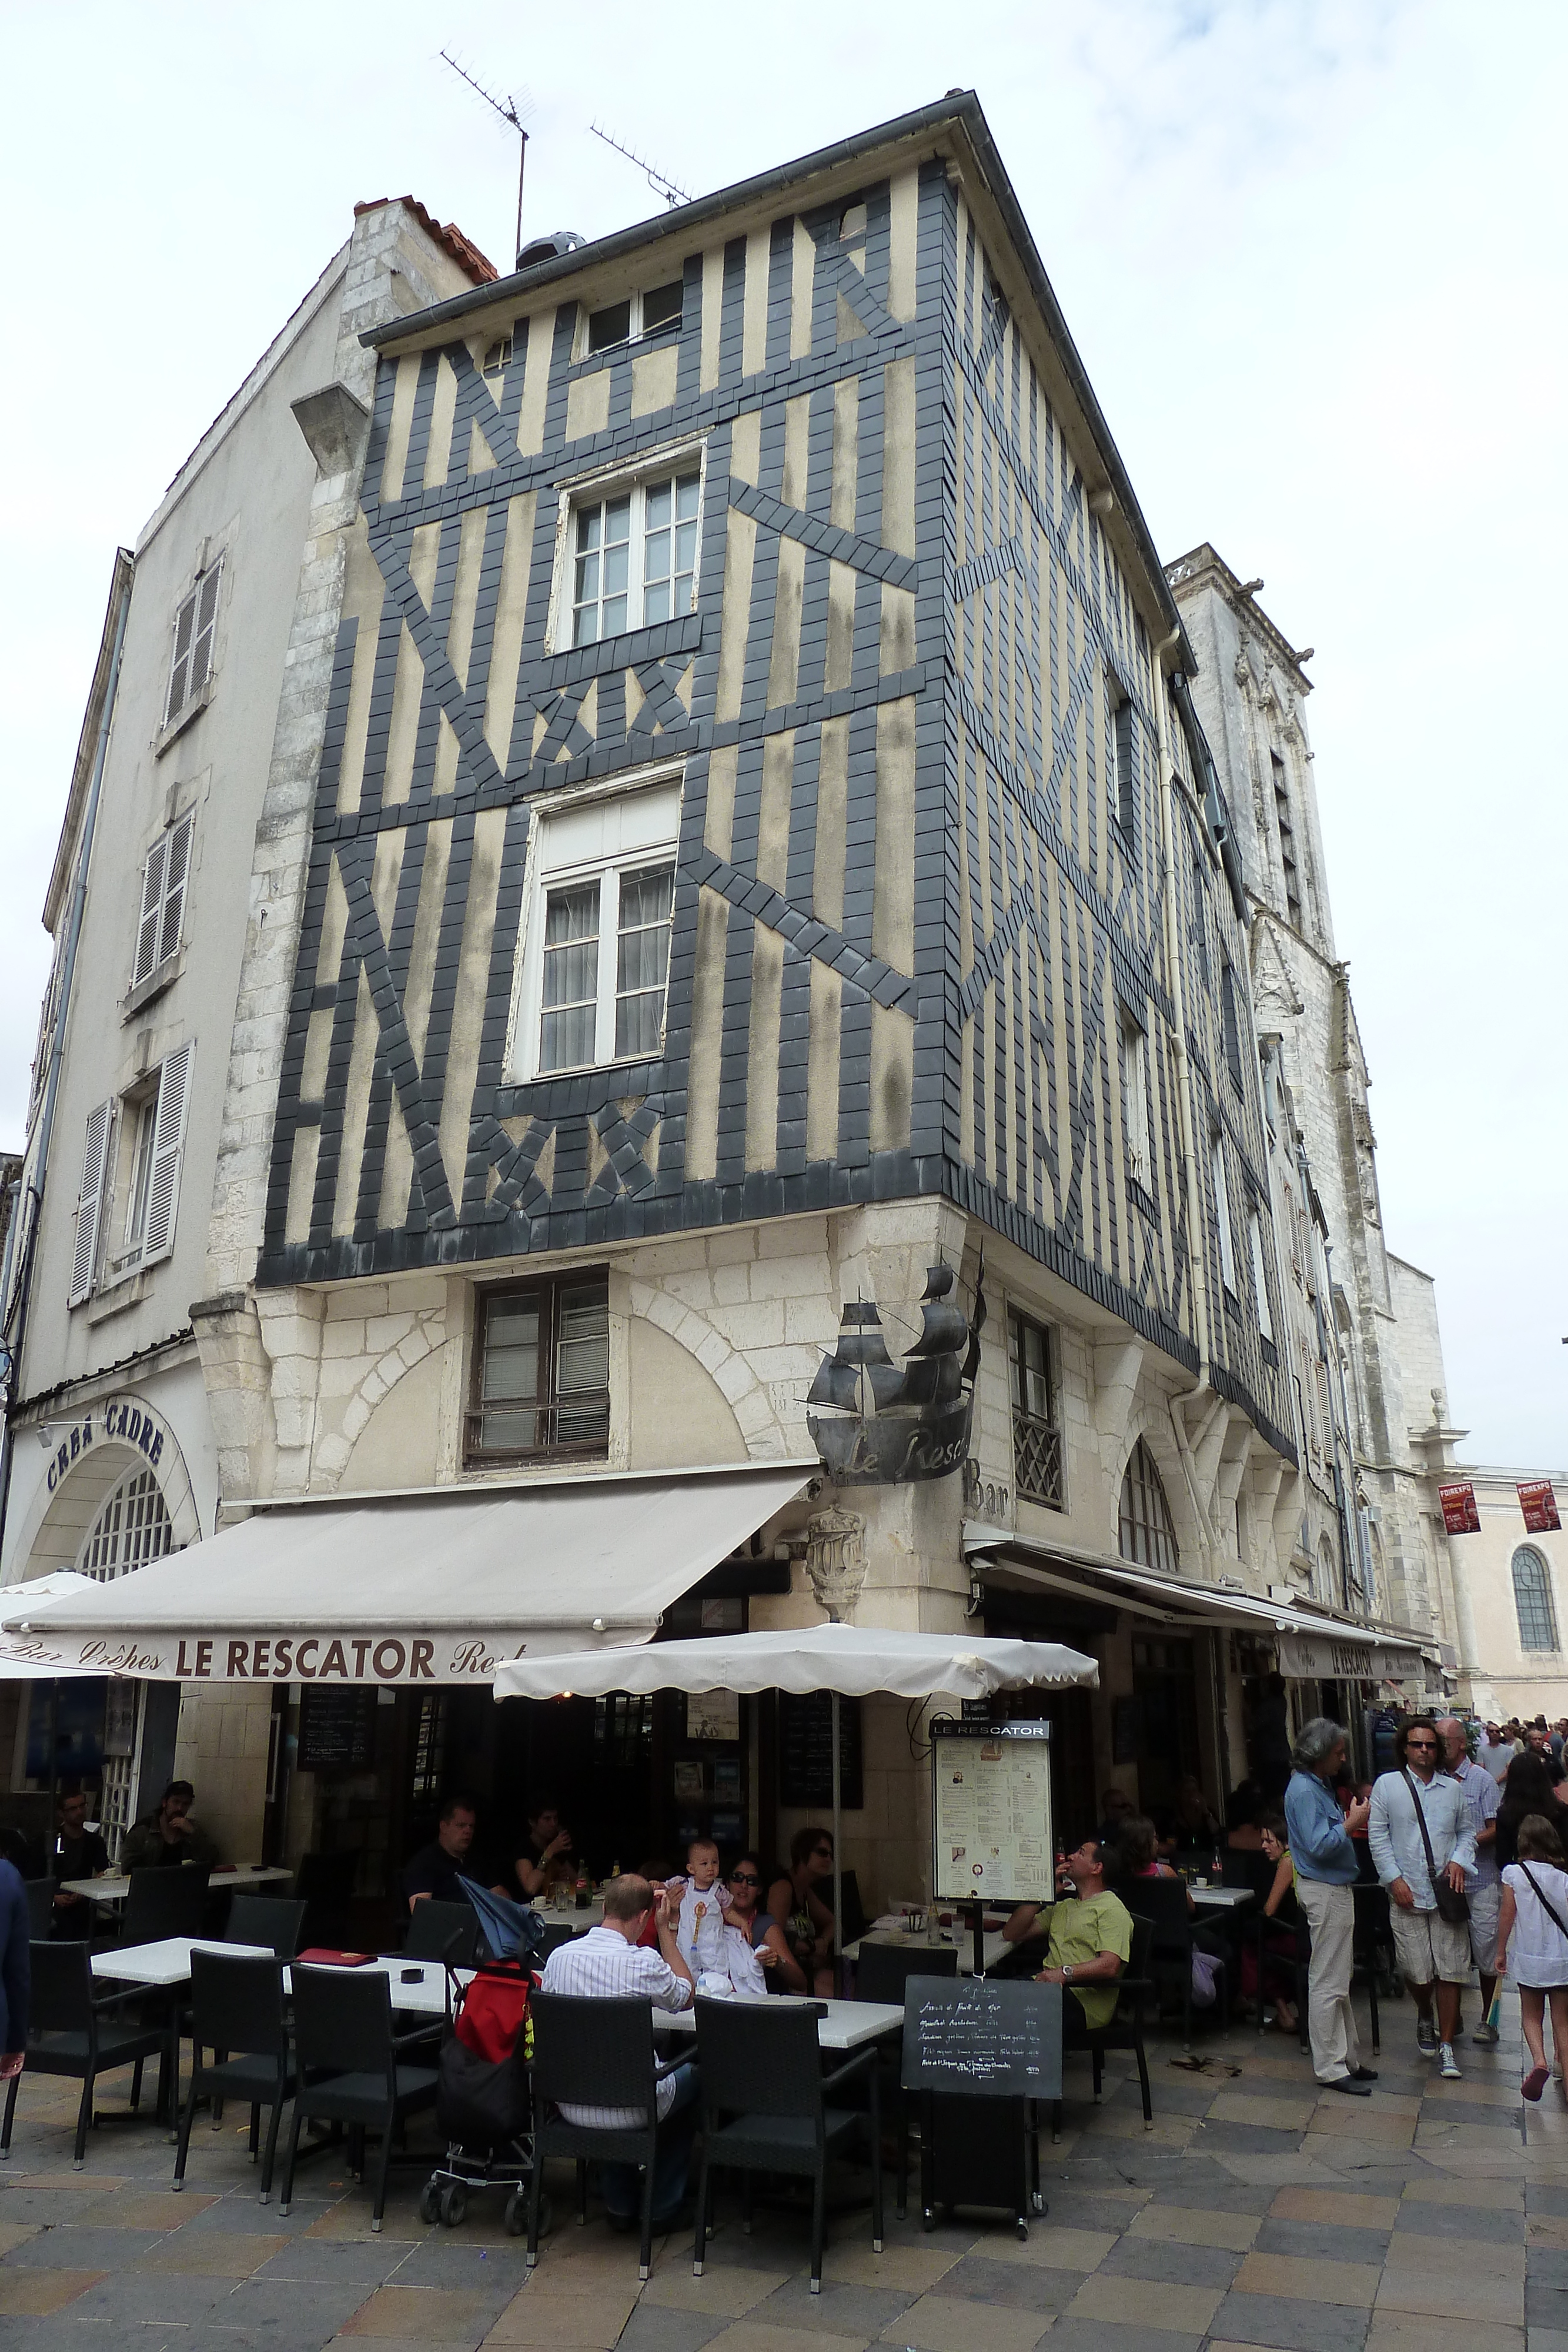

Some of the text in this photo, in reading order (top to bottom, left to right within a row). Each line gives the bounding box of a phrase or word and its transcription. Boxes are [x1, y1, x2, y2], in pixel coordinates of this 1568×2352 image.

[106, 1404, 165, 1465] CADRE
[962, 1457, 1008, 1519] Bar
[4, 1640, 71, 1662] Bar
[176, 1640, 213, 1677] LE
[226, 1639, 436, 1679] RESCATOR
[958, 1726, 1044, 1736] RESCATOR
